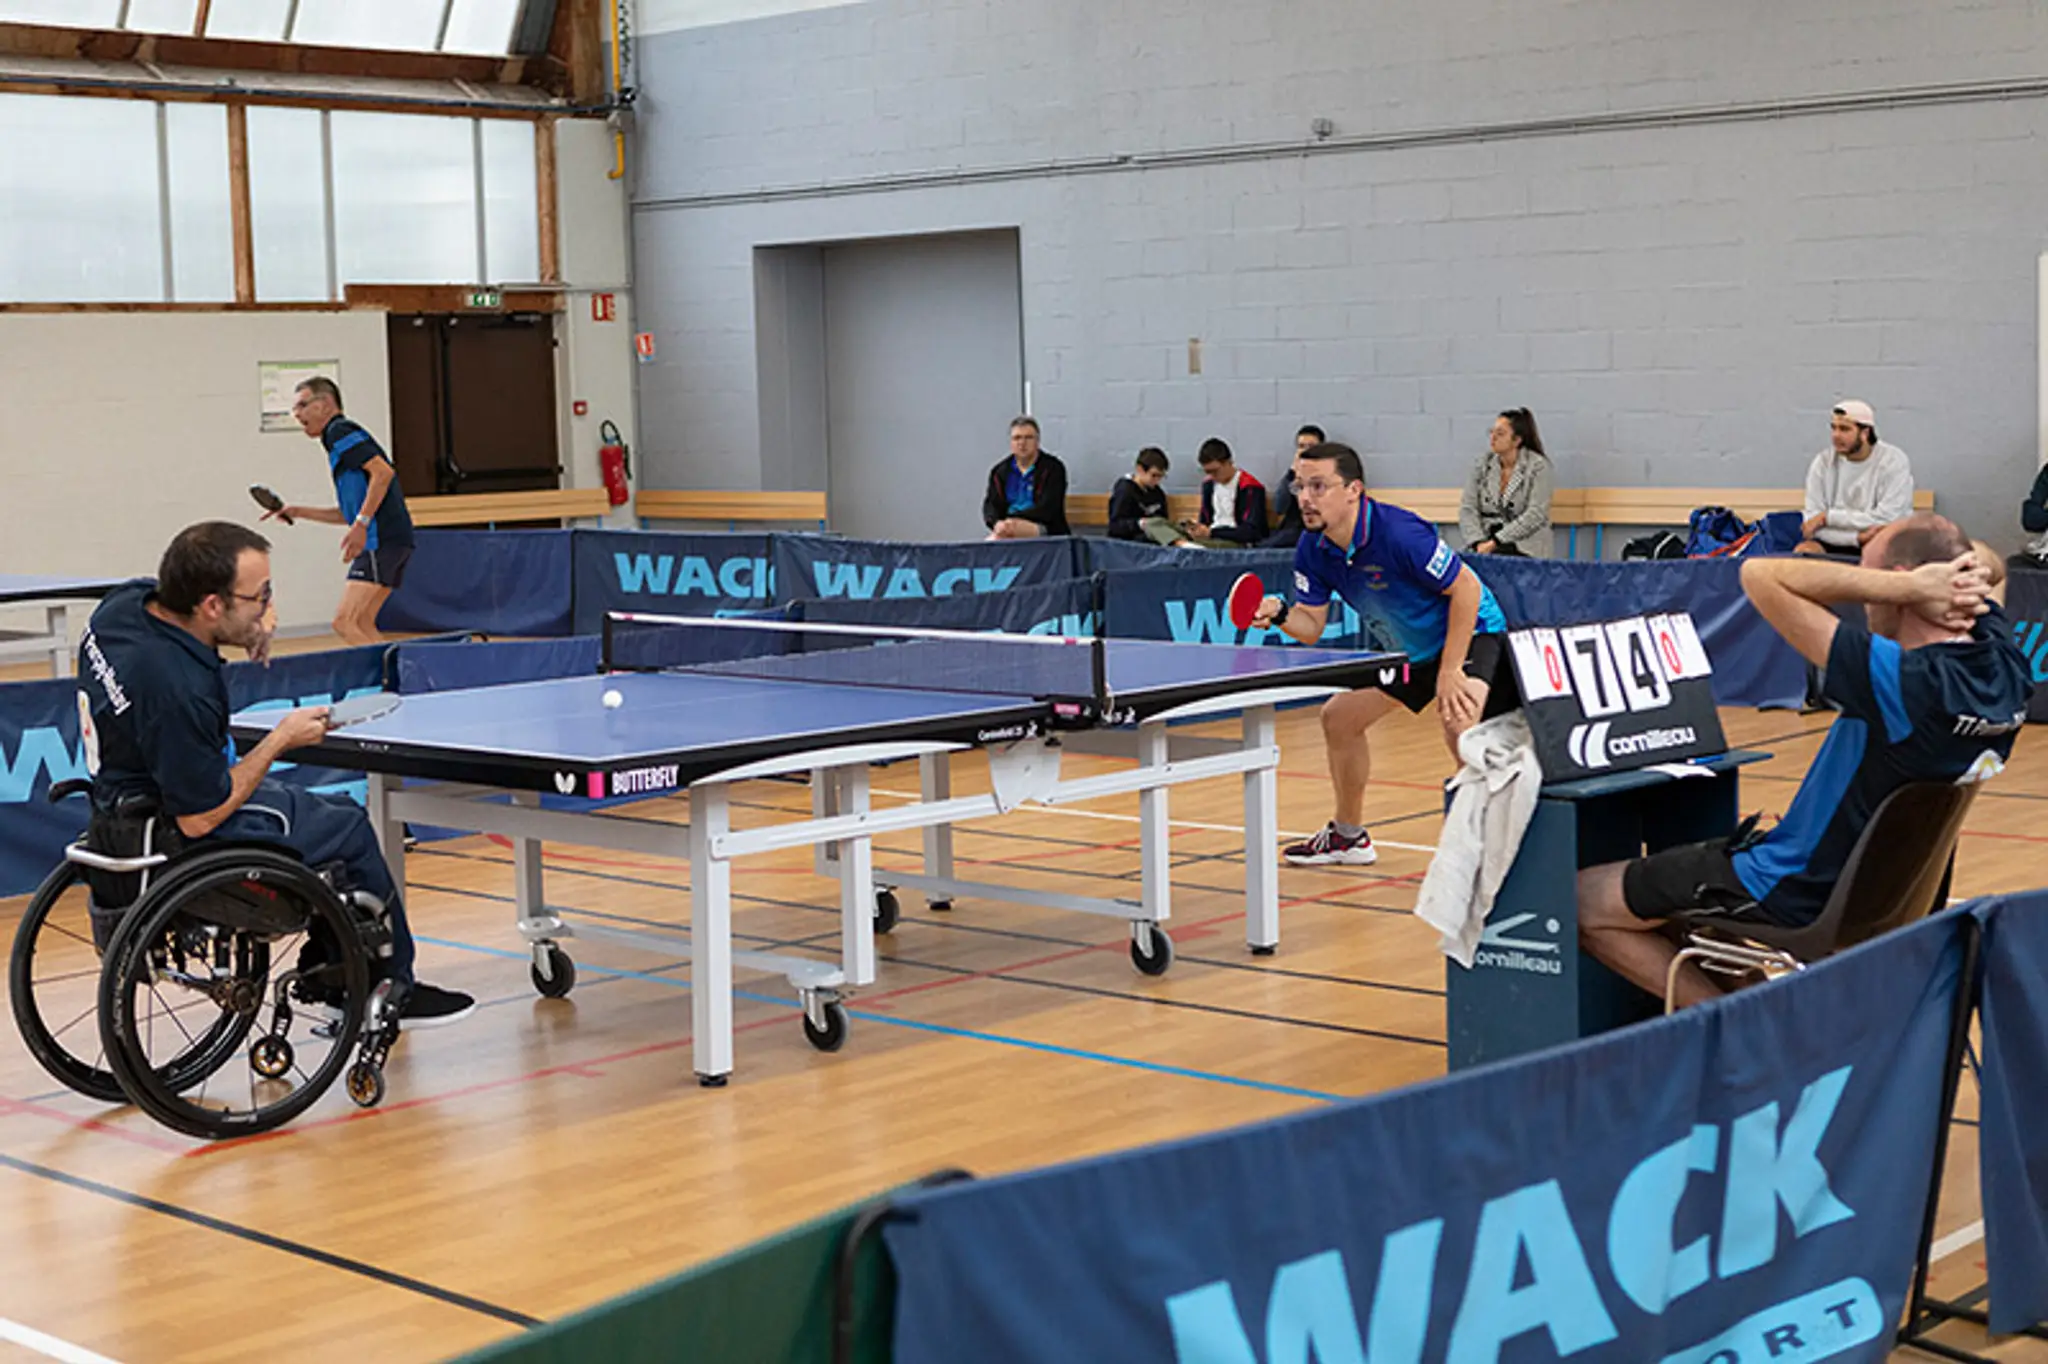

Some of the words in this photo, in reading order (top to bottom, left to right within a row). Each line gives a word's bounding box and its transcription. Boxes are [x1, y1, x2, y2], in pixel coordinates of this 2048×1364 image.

[1543, 644, 1563, 692] 0
[1574, 638, 1609, 708] 7
[1628, 632, 1660, 700] 4
[1660, 631, 1683, 674] 0
[612, 764, 679, 795] BUTTERFLY
[1474, 951, 1562, 975] ornilleau
[1165, 1065, 1857, 1364] WACK
